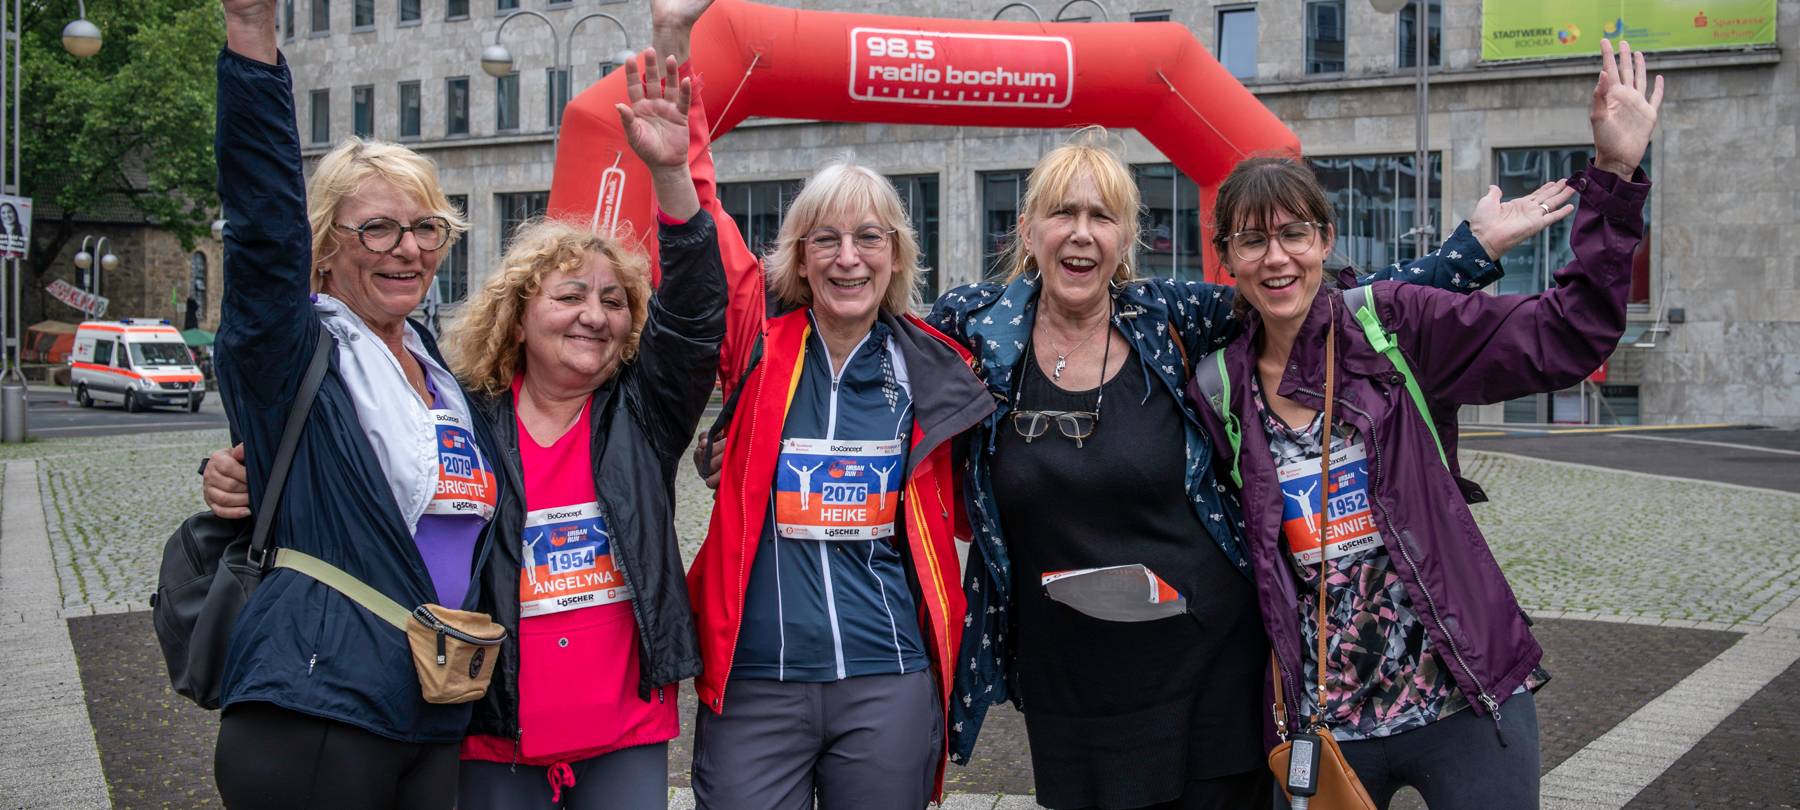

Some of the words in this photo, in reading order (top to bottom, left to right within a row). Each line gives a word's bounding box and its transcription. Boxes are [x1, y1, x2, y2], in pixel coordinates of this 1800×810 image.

[1493, 28, 1553, 39] STADTWERKE
[867, 37, 935, 60] 98.5
[1515, 38, 1554, 48] BOCHUM
[869, 63, 941, 84] radio
[945, 66, 1056, 88] bochum
[830, 445, 862, 453] BoConcept
[443, 456, 471, 477] 2079
[437, 480, 485, 498] BRIGITTE
[823, 485, 867, 503] 2076
[1328, 492, 1368, 518] 1952
[547, 510, 582, 520] BoConcept
[821, 508, 867, 522] HEIKE
[825, 528, 860, 537] LÖSCHER
[1338, 536, 1374, 552] LÖSCHER
[549, 550, 594, 572] 1954
[533, 571, 614, 594] ANGELYNA
[557, 594, 594, 607] LÖSCHER
